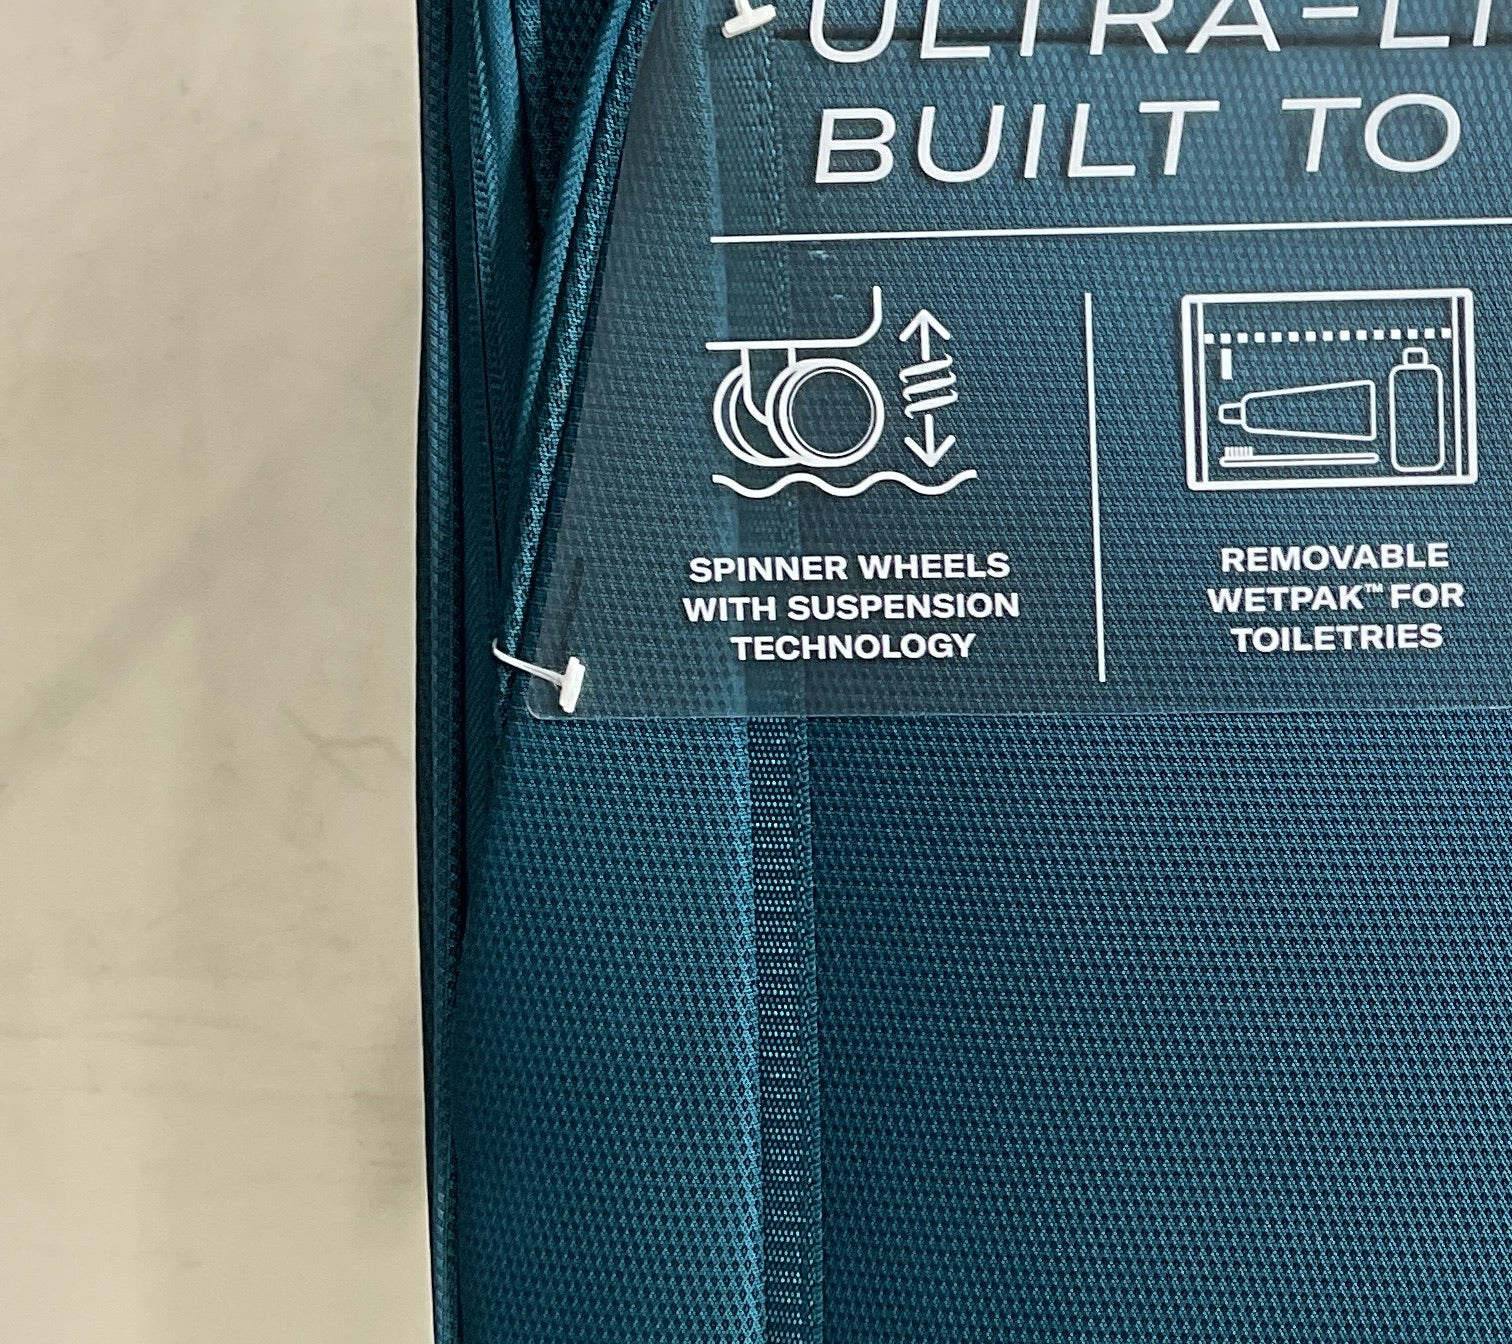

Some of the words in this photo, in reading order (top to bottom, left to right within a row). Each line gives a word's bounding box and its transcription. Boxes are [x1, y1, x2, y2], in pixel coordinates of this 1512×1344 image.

[815, 100, 1221, 184] BUILT
[1281, 93, 1461, 173] TO
[689, 555, 848, 583] SPINNER
[857, 552, 1011, 580] WHEELS
[1221, 541, 1449, 573] REMOVABLE
[682, 596, 777, 622] WITH
[787, 592, 1020, 621] SUSPENSION
[1390, 581, 1465, 609] FOR
[729, 632, 977, 661] TECHNOLOGY
[1230, 622, 1444, 653] TOILETRIES
